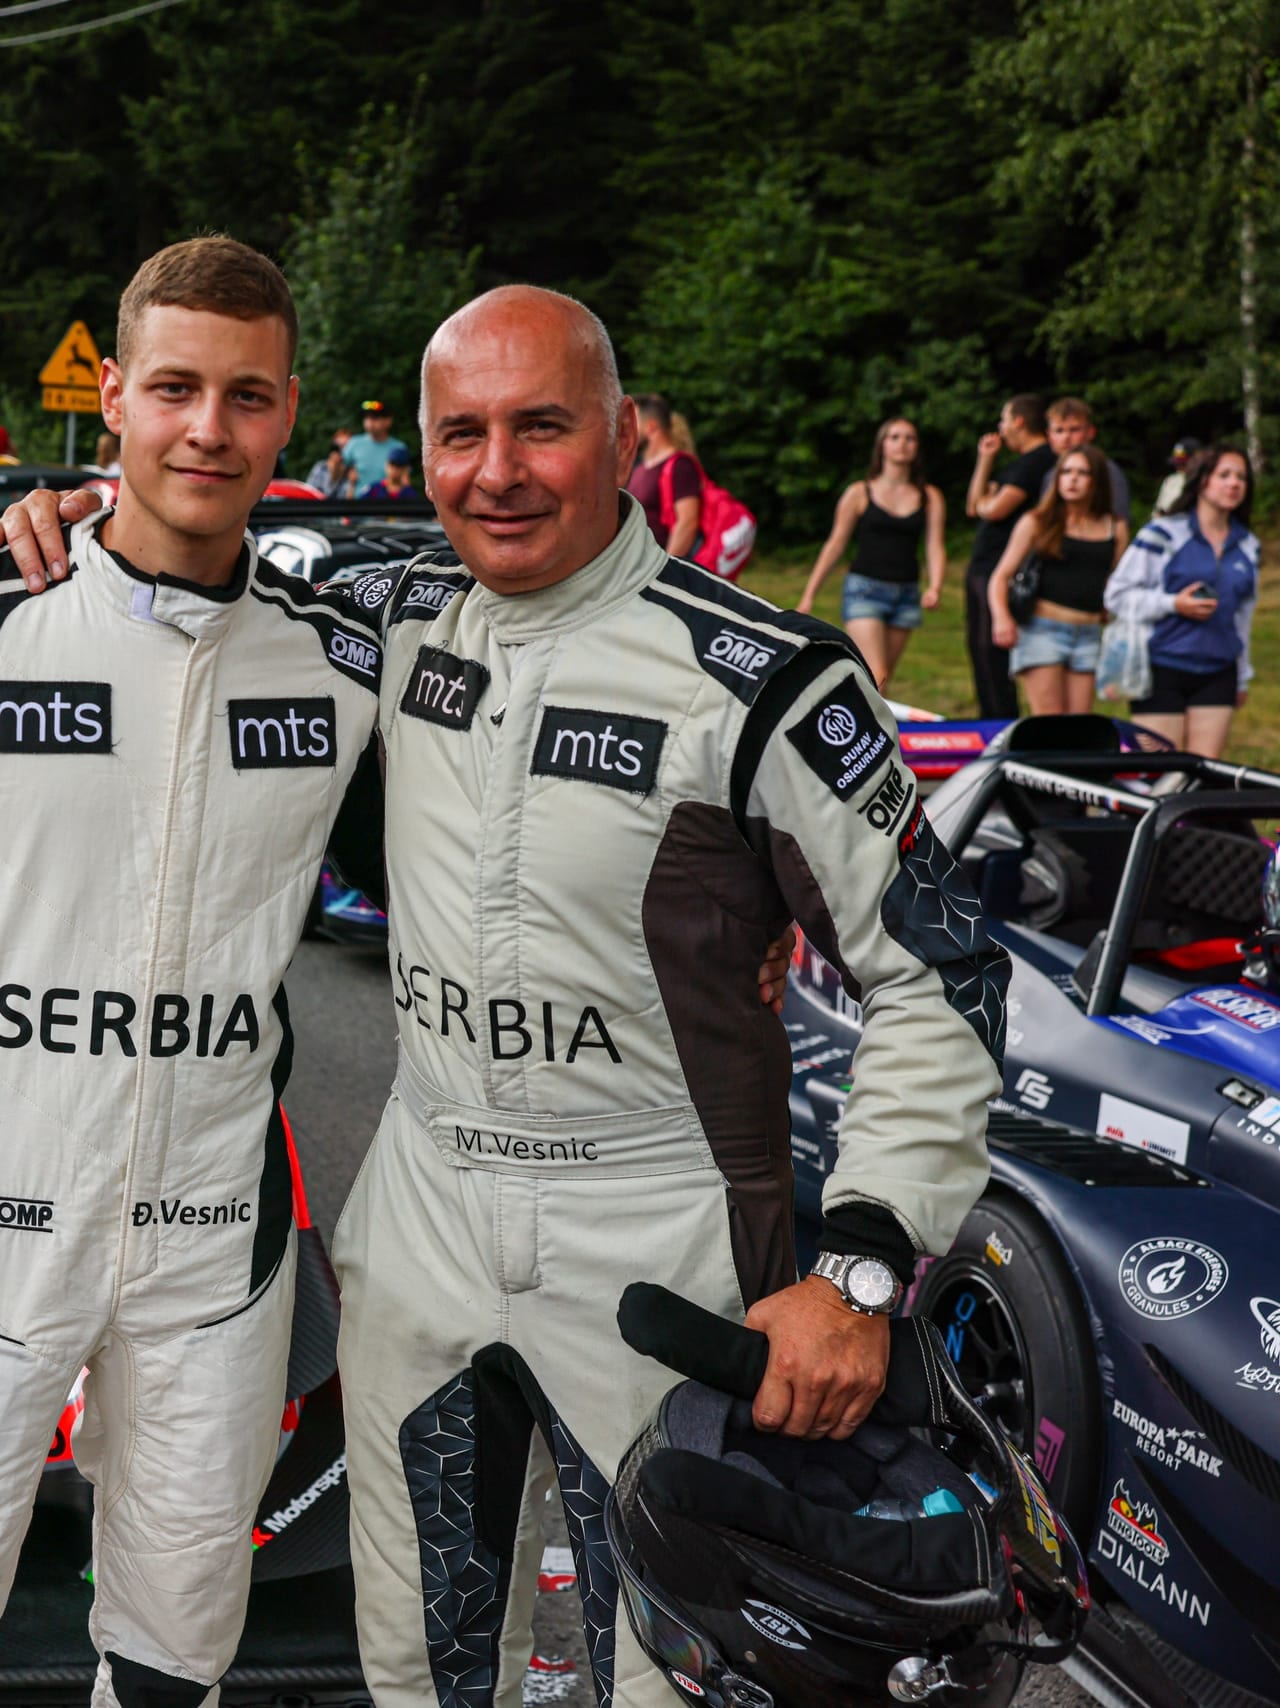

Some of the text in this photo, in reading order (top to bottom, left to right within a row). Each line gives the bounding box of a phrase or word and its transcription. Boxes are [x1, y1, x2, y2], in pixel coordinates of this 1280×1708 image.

[330, 634, 378, 669] OMP
[709, 635, 770, 673] OMP
[237, 708, 330, 758] mts
[550, 725, 644, 777] mts
[840, 731, 874, 767] DUNAV
[836, 732, 887, 790] OSIGURANJE
[866, 767, 906, 830] OMP
[395, 951, 623, 1064] SERBIA
[455, 1124, 599, 1161] M.Vesnic
[1236, 1117, 1280, 1152] IND
[1140, 1240, 1224, 1293] ALSACE ENERGIES
[1122, 1268, 1191, 1316] ET GRANULES
[1112, 1399, 1167, 1449] EUROPA
[1174, 1437, 1224, 1478] PARK
[1135, 1435, 1182, 1472] RESORT
[262, 1453, 347, 1534] Motorspo
[1097, 1528, 1211, 1627] DIALANN
[758, 1614, 792, 1637] RS7
[675, 1673, 701, 1694] BELL
